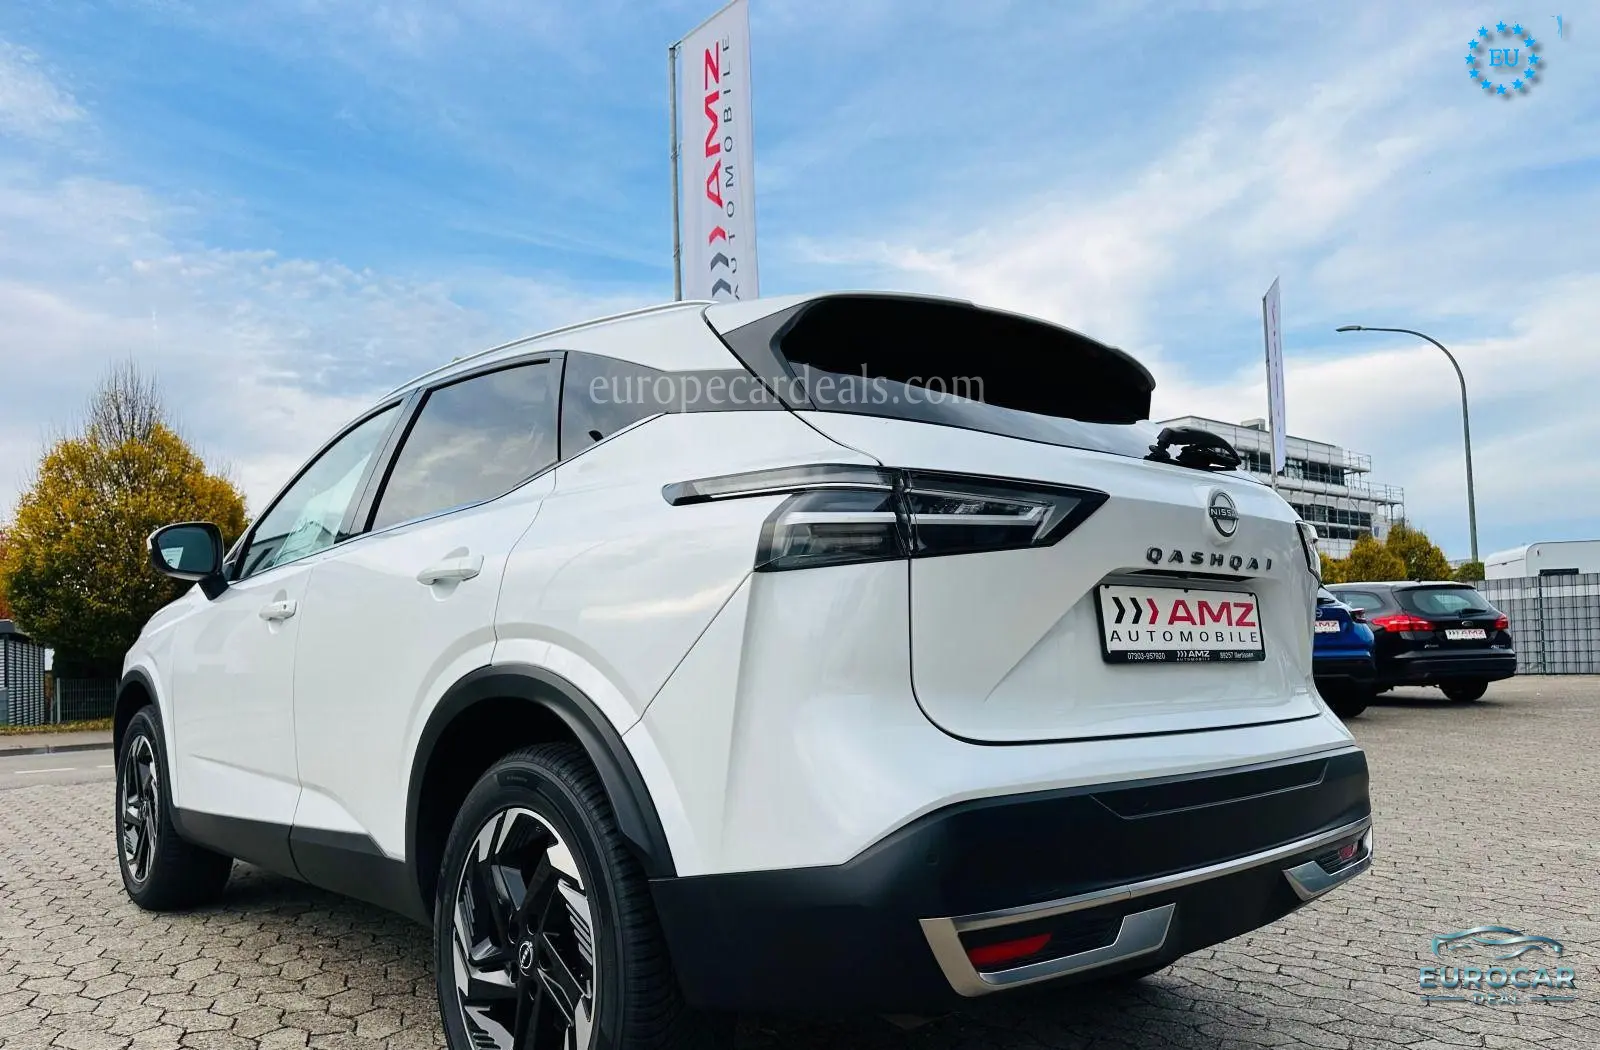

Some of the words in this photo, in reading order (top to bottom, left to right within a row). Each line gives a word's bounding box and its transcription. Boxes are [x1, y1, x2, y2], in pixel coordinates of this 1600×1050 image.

[704, 41, 723, 208] AMZ
[1146, 547, 1273, 571] QASHQAI
[1167, 599, 1256, 627] AMZ
[1110, 630, 1259, 643] AUTOMOBILE
[1188, 650, 1210, 658] AMZ
